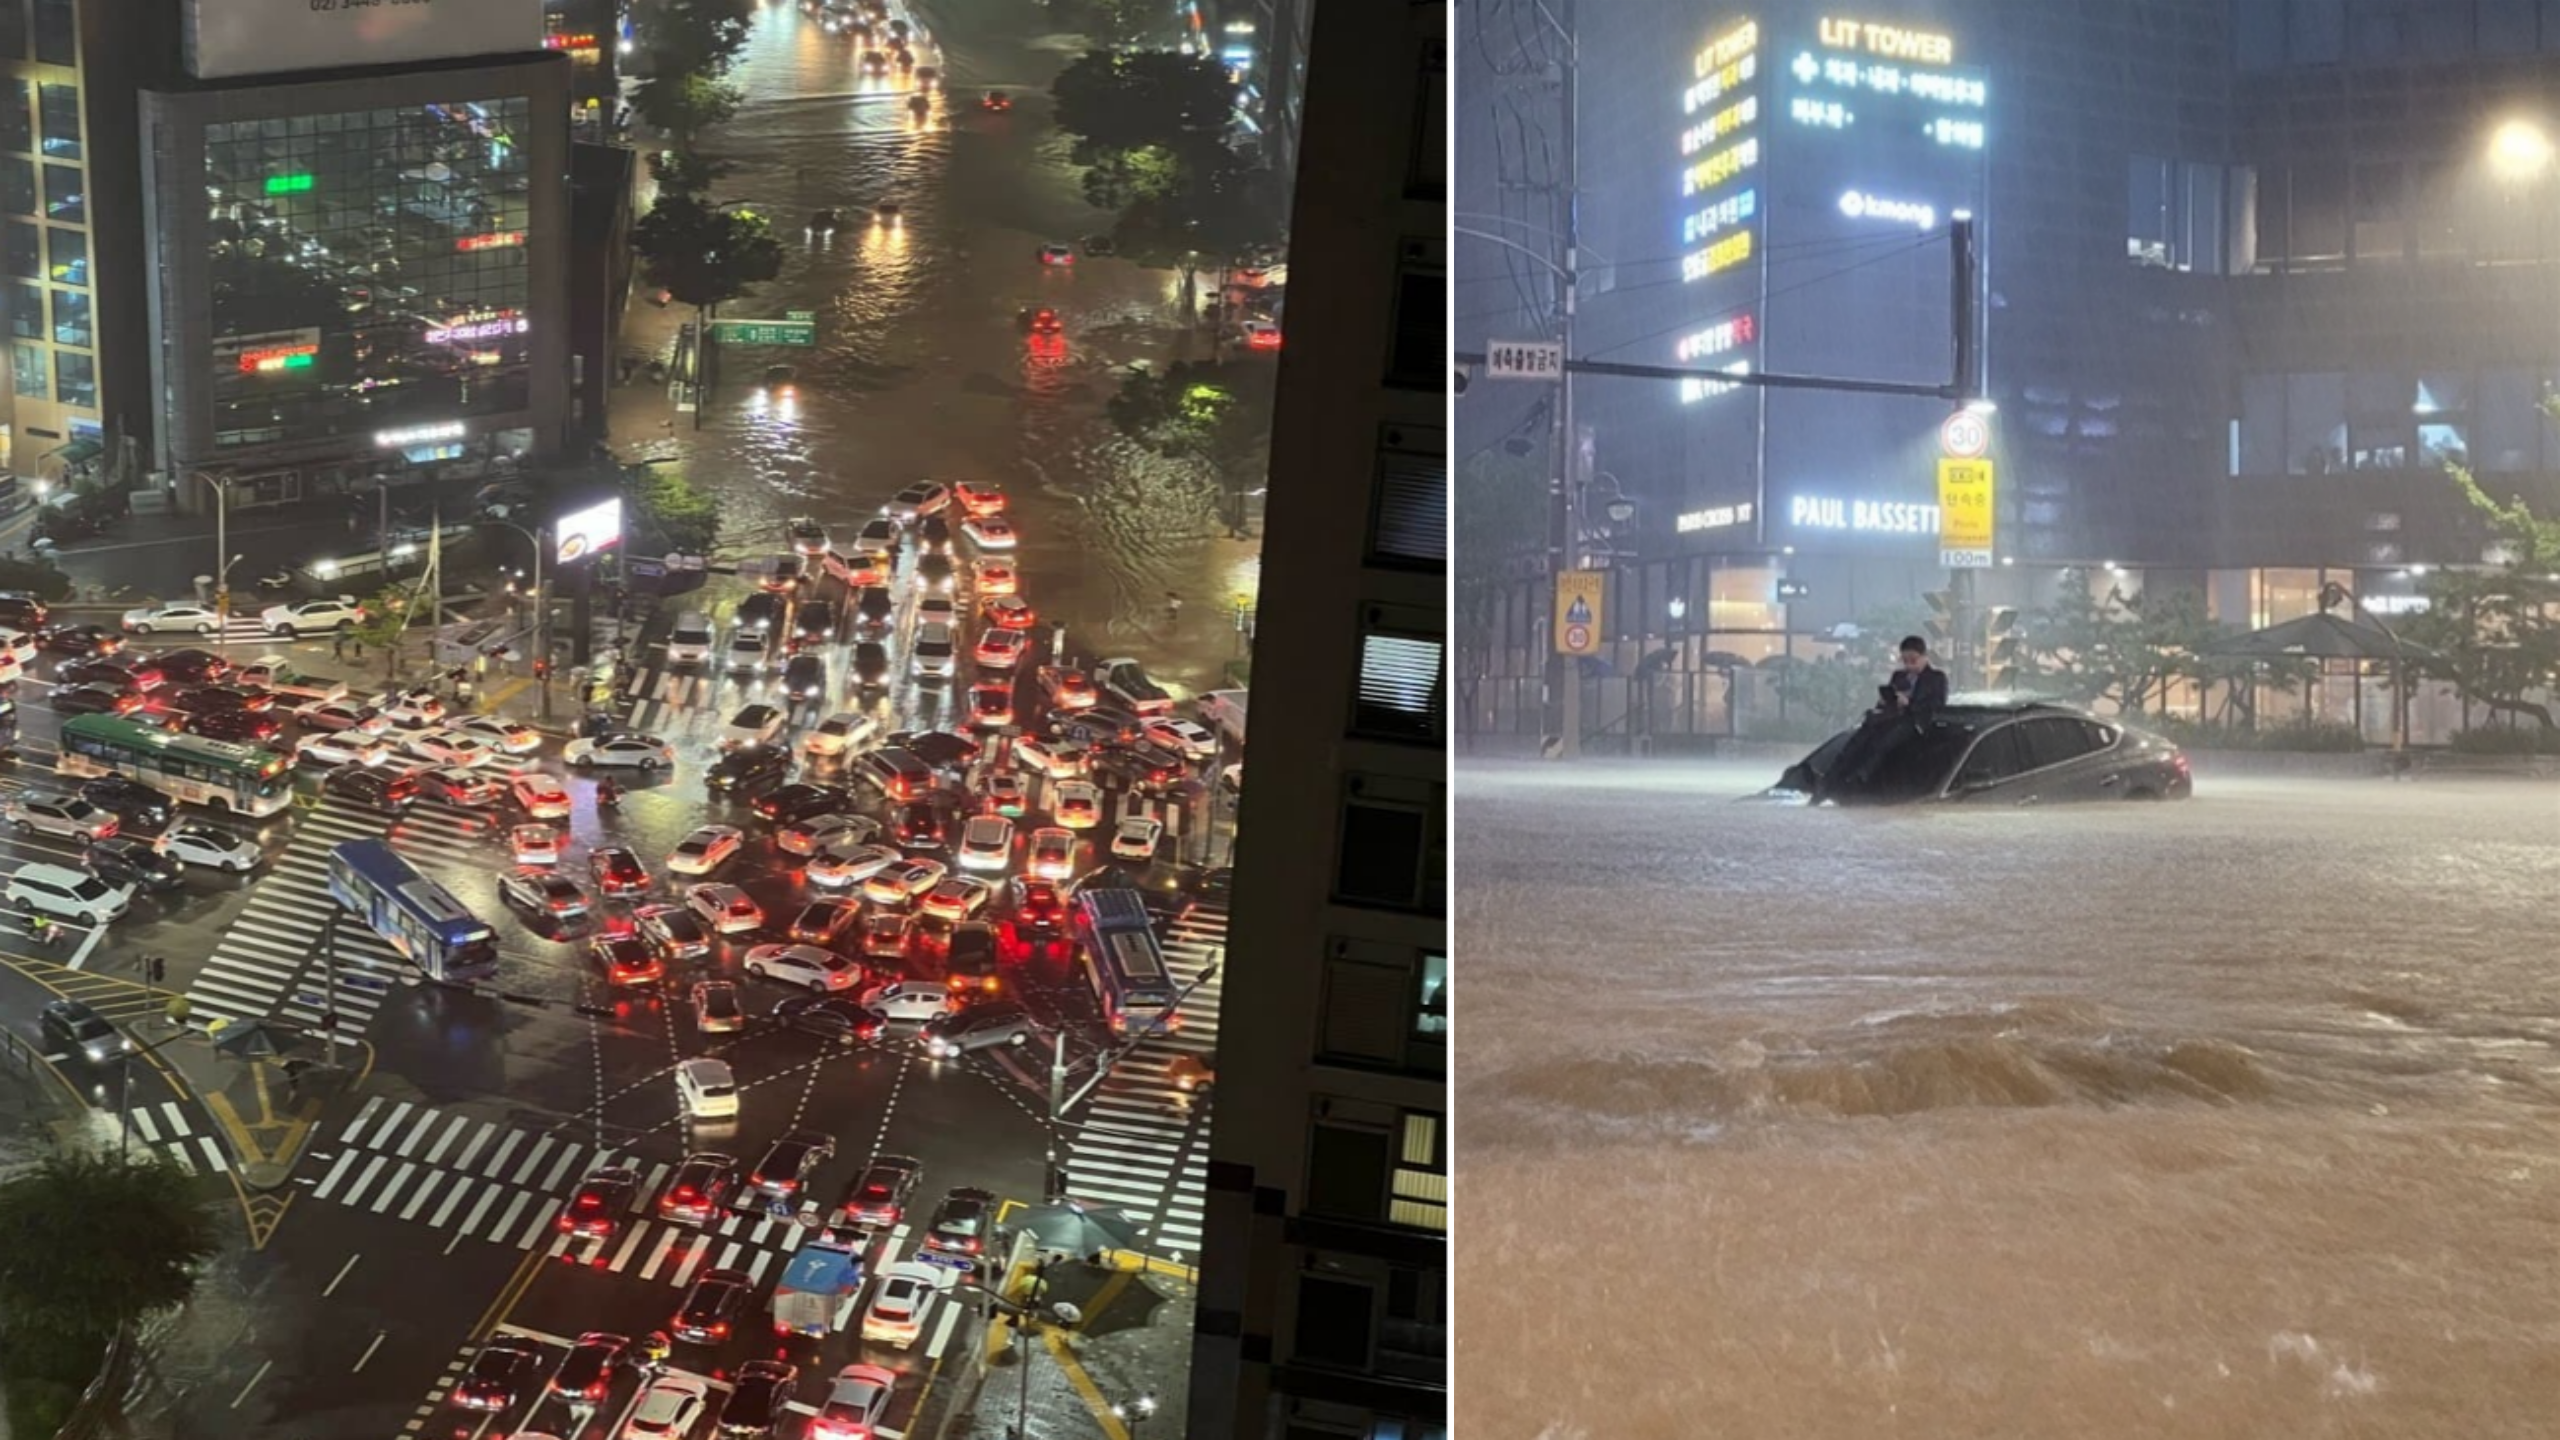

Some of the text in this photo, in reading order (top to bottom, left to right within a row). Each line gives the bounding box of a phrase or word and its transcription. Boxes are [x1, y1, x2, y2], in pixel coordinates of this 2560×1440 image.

[1695, 21, 1757, 79] LIT TOWER
[1820, 17, 1951, 64] LIT TOWER
[1493, 347, 1557, 371] 예측출발금지
[1951, 426, 1980, 446] 30
[1792, 495, 1847, 528] PAUL
[1852, 500, 1940, 534] BASSETT
[1944, 551, 1988, 566] 100m
